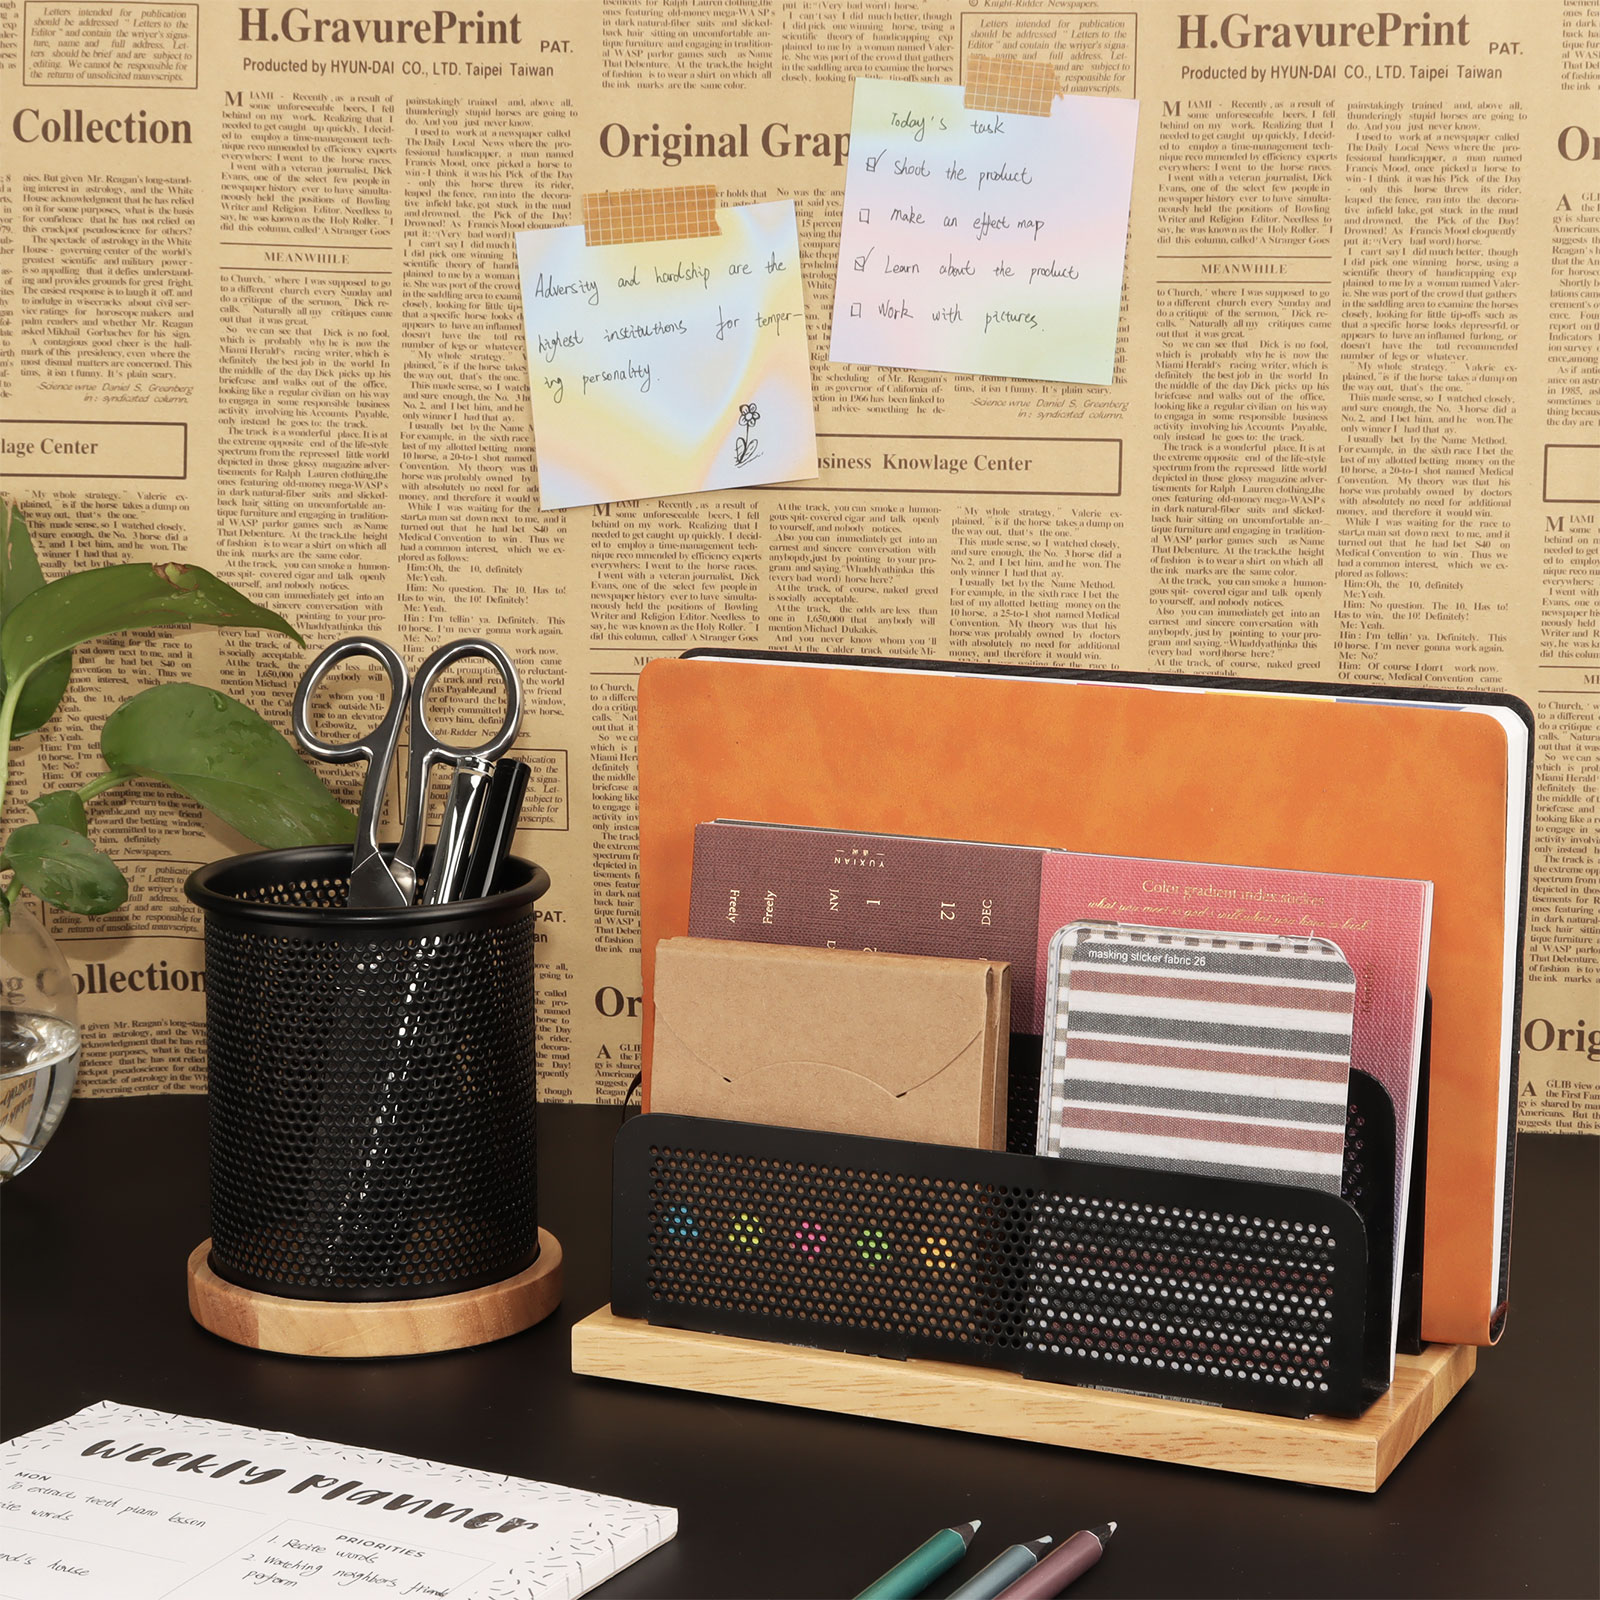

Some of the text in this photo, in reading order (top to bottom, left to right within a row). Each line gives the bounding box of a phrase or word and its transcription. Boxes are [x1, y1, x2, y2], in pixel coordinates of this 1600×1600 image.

[239, 8, 574, 52] H.GravurePrint PAT.
[1178, 12, 1524, 54] H.GravurePrint PAT.
[244, 58, 553, 79] Producted by HYUN-DAI CO., LTD. Taipei Taiwan
[1182, 65, 1502, 82] Producted by HYUN-DAI CO., LTD. Taipei Taiwan
[13, 109, 192, 143] Collection
[891, 111, 1004, 142] Today's task
[600, 123, 748, 167] Original
[894, 158, 1032, 190] Shoot the product
[944, 216, 957, 226] an
[973, 212, 1009, 240] effect
[1018, 220, 1044, 240] map
[265, 252, 347, 263] MEANWHILE
[885, 254, 1078, 284] Learn about the product
[1202, 264, 1286, 273] MEANWHILE
[535, 252, 786, 305] Adversity and hardship are the
[879, 299, 913, 319] Work
[932, 304, 962, 323] with
[538, 330, 583, 363] highest
[716, 306, 739, 340] for
[41, 439, 98, 454] Center
[884, 454, 967, 473] Knowlage
[974, 455, 1032, 470] Center
[834, 857, 885, 867] YUXIAN
[829, 888, 839, 911] JAN
[1142, 880, 1180, 894] Color
[1184, 884, 1236, 900] gradient
[1241, 888, 1277, 902] index
[726, 890, 741, 923] Freely
[763, 890, 778, 924] Freely
[941, 902, 955, 920] 12
[982, 900, 992, 925] DEC
[1088, 950, 1206, 966] masking sticker fabric 26
[15, 1472, 51, 1481] MON
[80, 1439, 539, 1534] weekly planner
[336, 1535, 424, 1559] PRIORITIES
